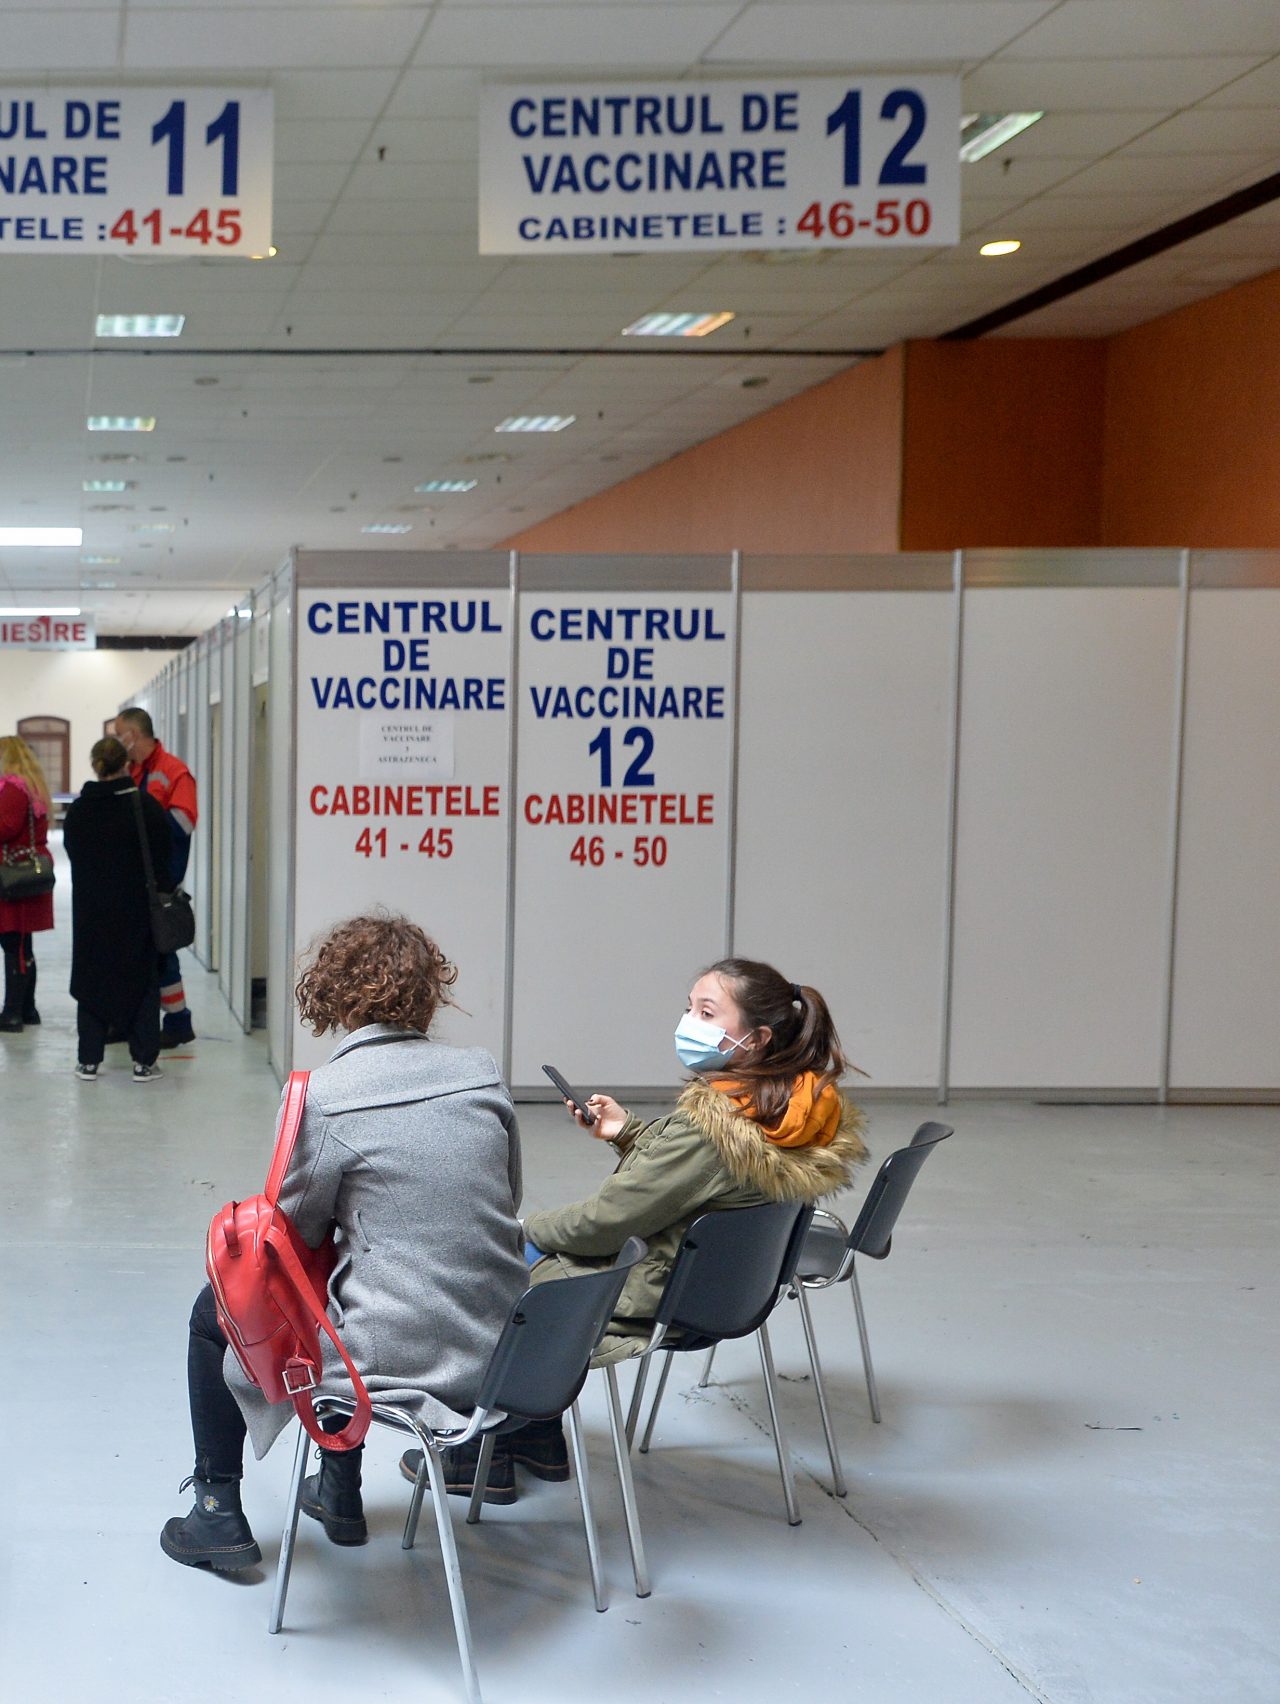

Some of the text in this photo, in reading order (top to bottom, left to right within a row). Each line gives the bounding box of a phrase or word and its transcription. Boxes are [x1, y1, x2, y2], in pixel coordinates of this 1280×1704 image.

[64, 99, 120, 140] DE
[509, 91, 800, 138] CENTRUL DE
[150, 99, 241, 197] 11
[825, 87, 928, 188] 12
[522, 148, 787, 194] VACCINARE
[518, 211, 763, 241] CABINETELE
[796, 197, 932, 240] 46-50
[307, 600, 503, 635] CENTRUL
[529, 608, 726, 642] CENTRUL
[382, 638, 431, 673] DE
[606, 646, 655, 681] DE
[310, 676, 506, 711] VACCINARE
[530, 685, 726, 720] VACCINARE
[588, 725, 656, 789] 12
[309, 784, 500, 817] CABINETELE
[524, 793, 714, 825] CABINETELE
[355, 827, 388, 858] 41
[418, 827, 454, 859] 45
[569, 835, 606, 867] 46
[632, 835, 668, 868] 50
